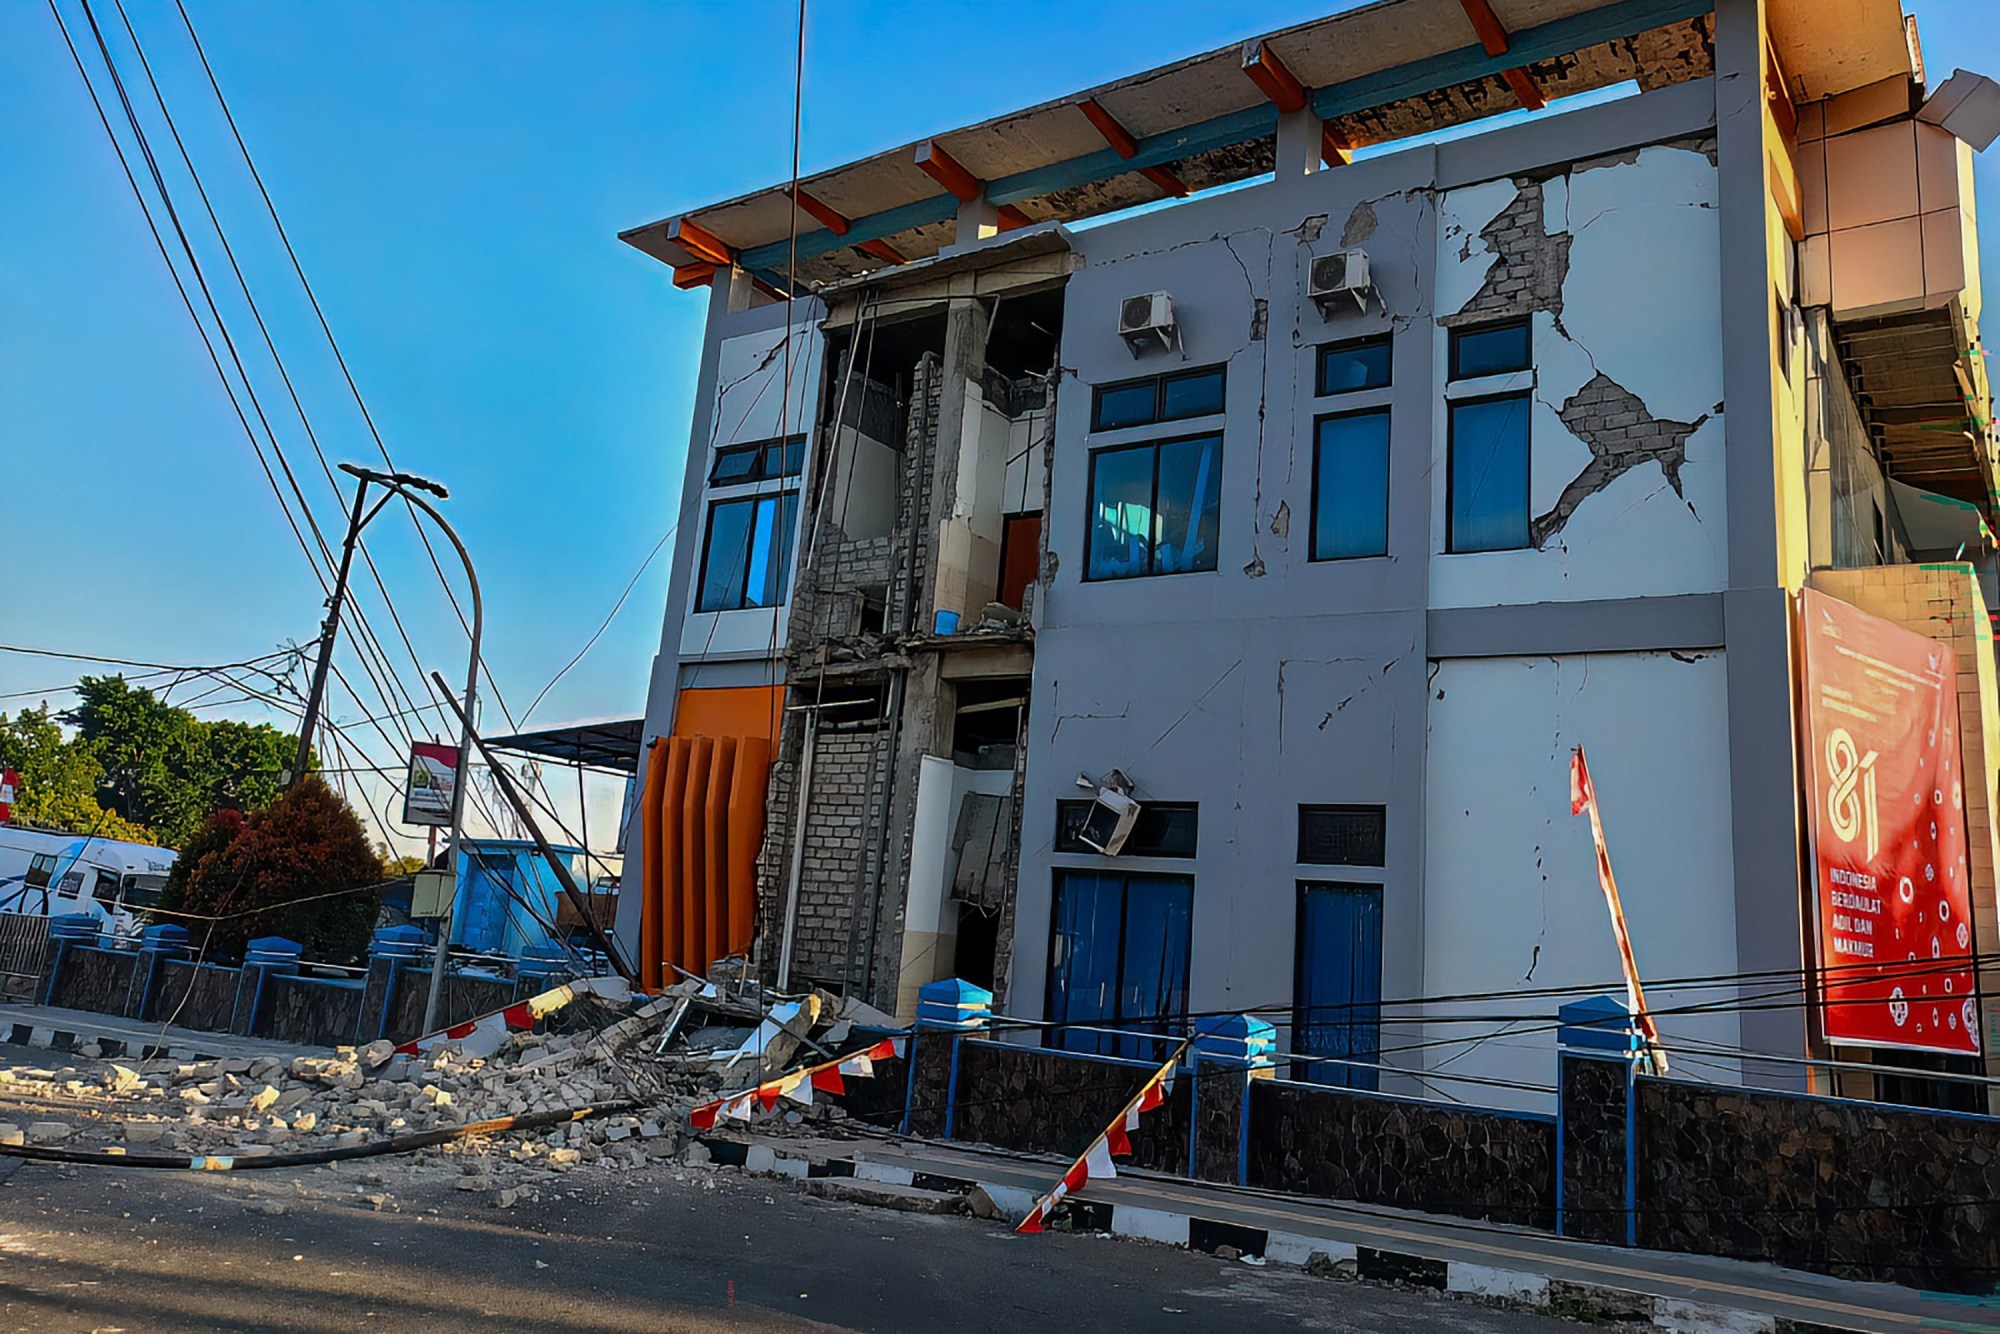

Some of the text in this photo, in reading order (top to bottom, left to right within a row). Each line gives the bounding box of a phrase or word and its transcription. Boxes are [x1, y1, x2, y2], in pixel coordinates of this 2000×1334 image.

[1825, 727, 1879, 864] 81
[1830, 867, 1876, 890] INDONESIA
[1854, 917, 1872, 935] DAN
